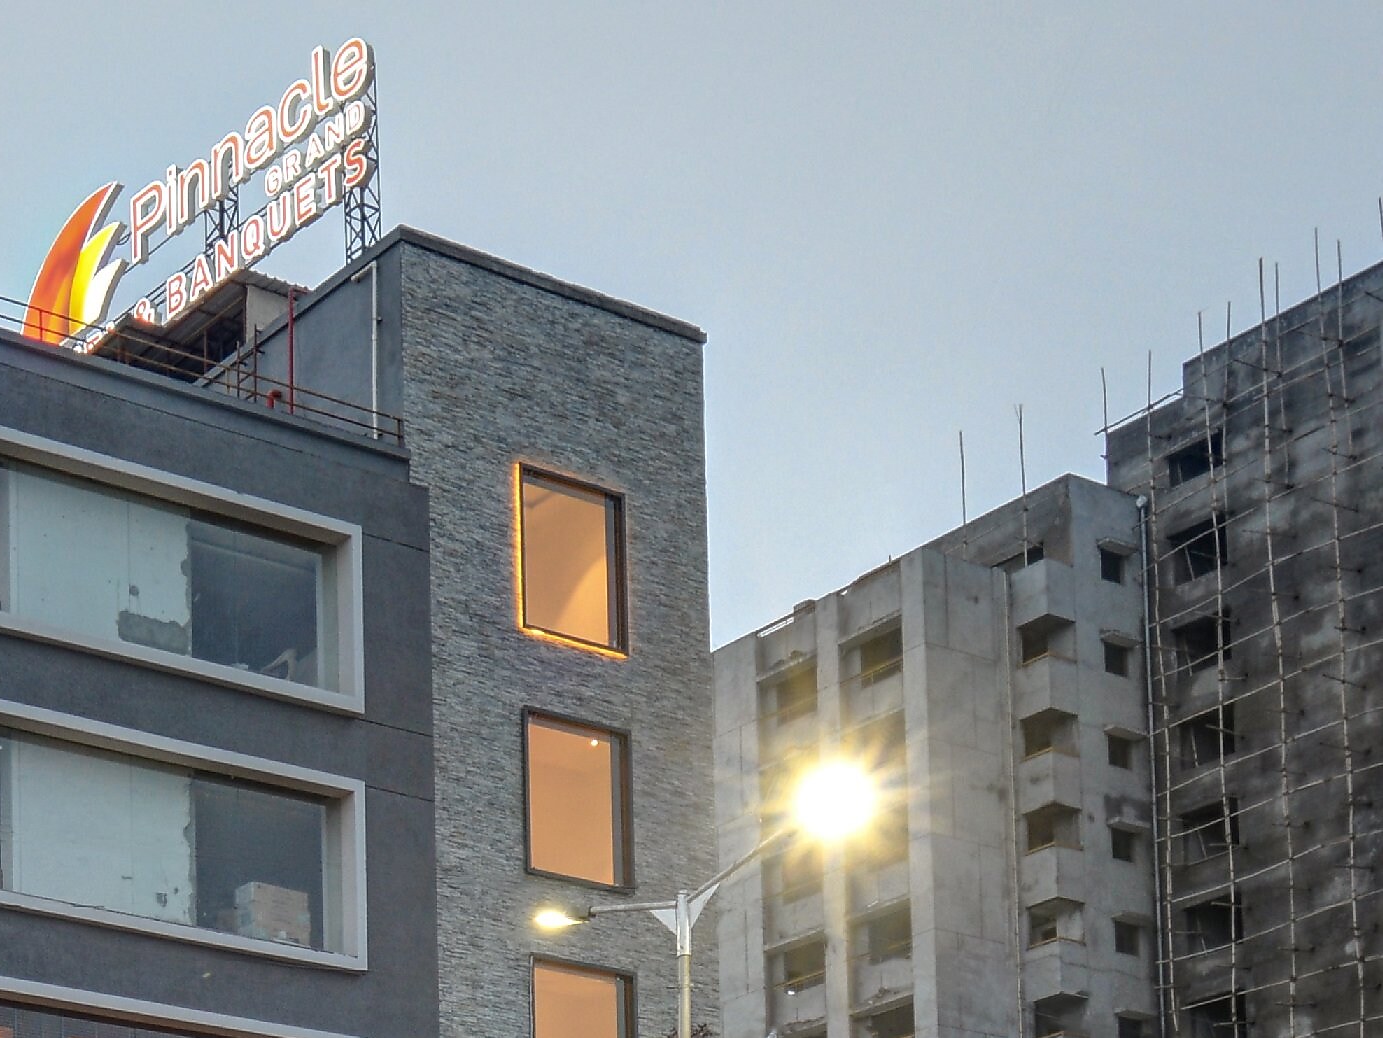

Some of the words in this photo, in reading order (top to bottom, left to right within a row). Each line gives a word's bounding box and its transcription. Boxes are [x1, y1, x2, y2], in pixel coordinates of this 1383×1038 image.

[130, 37, 370, 263] Pinnacle
[165, 138, 368, 323] BANQUETS
[265, 100, 367, 197] GRAND
